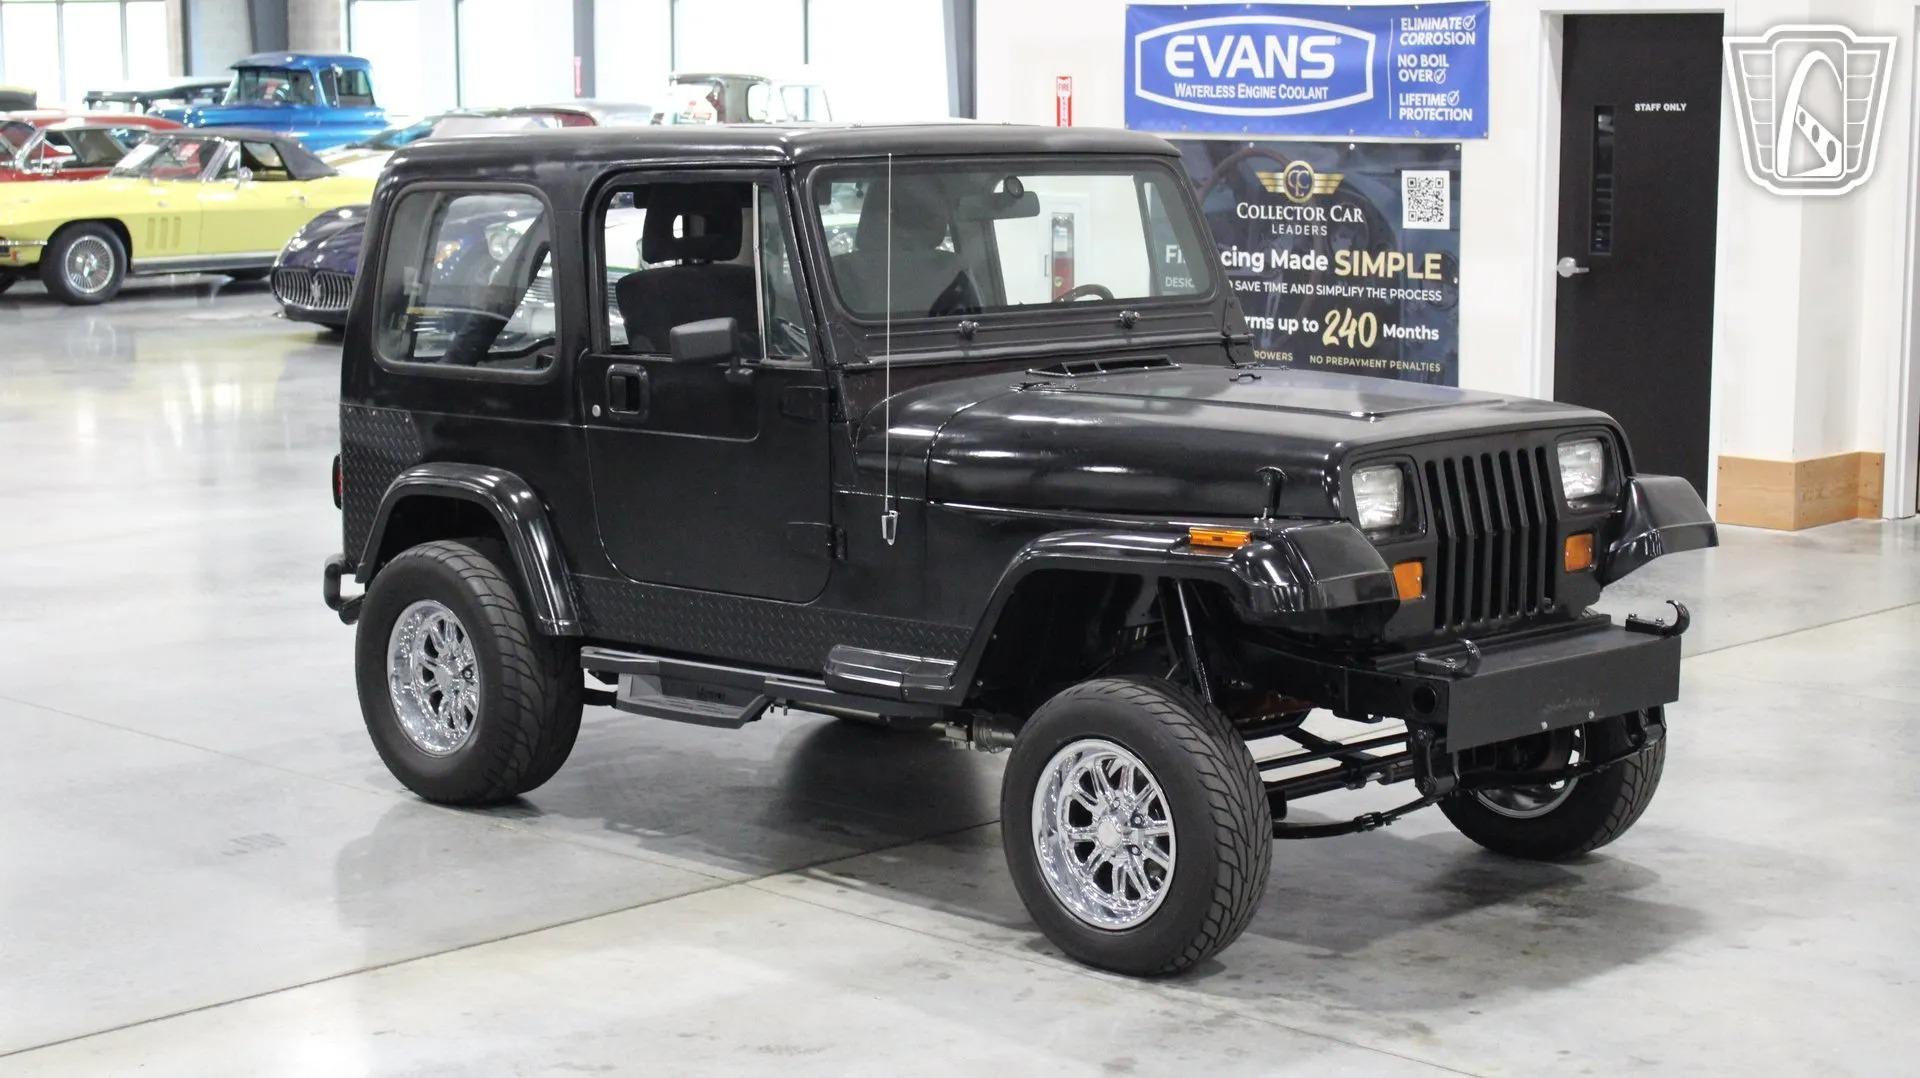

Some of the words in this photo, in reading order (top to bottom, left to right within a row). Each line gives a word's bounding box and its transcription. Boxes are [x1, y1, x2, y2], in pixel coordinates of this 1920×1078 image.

[1401, 17, 1462, 31] ELIMINATE
[1400, 32, 1476, 46] CORROSION
[1165, 34, 1338, 80] EVANS
[1398, 54, 1418, 68] NO
[1420, 54, 1449, 68] BOIL
[1399, 69, 1434, 82] OVER
[1174, 83, 1236, 98] WATERLESS
[1238, 84, 1276, 99] ENGINE
[1278, 84, 1328, 100] COOLANT
[1399, 93, 1447, 106] LIFETIME
[1399, 107, 1473, 122] PROTECTION
[1634, 103, 1661, 112] STAFF
[1663, 103, 1687, 112] ONLY
[1236, 202, 1327, 221] COLLECTOR
[1330, 205, 1364, 223] CAR
[1271, 223, 1328, 237] LEADERS
[1271, 249, 1329, 271] Made
[1334, 250, 1442, 281] SIMPLE
[1235, 280, 1261, 292] SAVE
[1263, 281, 1288, 293] TIME
[1290, 283, 1314, 295] AND
[1316, 284, 1364, 298] SIMPLIFY
[1366, 287, 1387, 299] THE
[1390, 288, 1442, 302] PROCESS
[1278, 318, 1299, 335] up
[1302, 317, 1319, 333] to
[1322, 307, 1377, 349] 240
[1382, 323, 1440, 341] Months
[1254, 350, 1293, 361] ROWERS
[1309, 355, 1323, 364] NO
[1325, 356, 1387, 369] PREPAYMENT
[1389, 361, 1441, 373] PENALTIES
